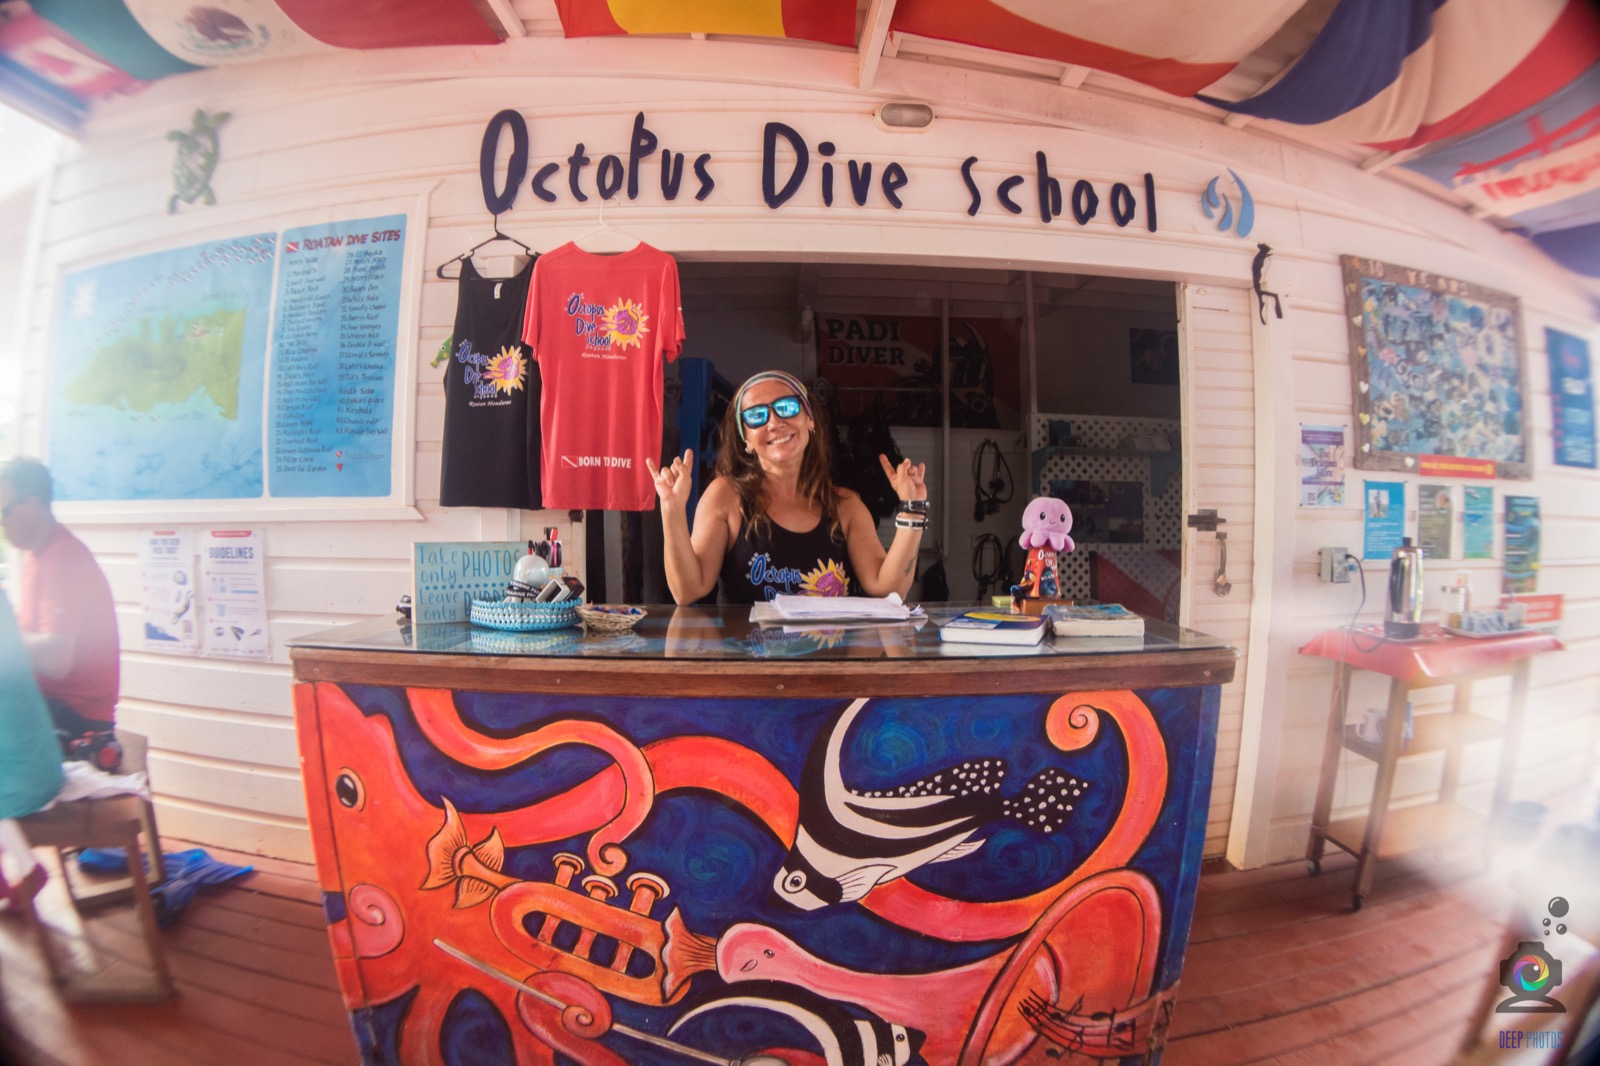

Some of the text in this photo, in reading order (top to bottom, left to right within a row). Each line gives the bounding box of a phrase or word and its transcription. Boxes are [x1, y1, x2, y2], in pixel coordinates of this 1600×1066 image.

[763, 122, 907, 211] Dive
[961, 151, 1158, 233] School
[345, 233, 368, 246] DIVE
[371, 229, 401, 243] SITES
[567, 294, 605, 322] Octopus
[576, 318, 596, 336] Dive
[825, 318, 900, 342] PADI
[828, 345, 906, 367] DIVER
[578, 456, 601, 467] BORN
[611, 456, 632, 469] DIVE
[208, 546, 254, 560] GUIDELINES
[418, 546, 459, 565] Take
[420, 565, 457, 585] only
[750, 554, 802, 592] Octopus
[419, 586, 460, 605] Leave
[424, 604, 457, 622] only
